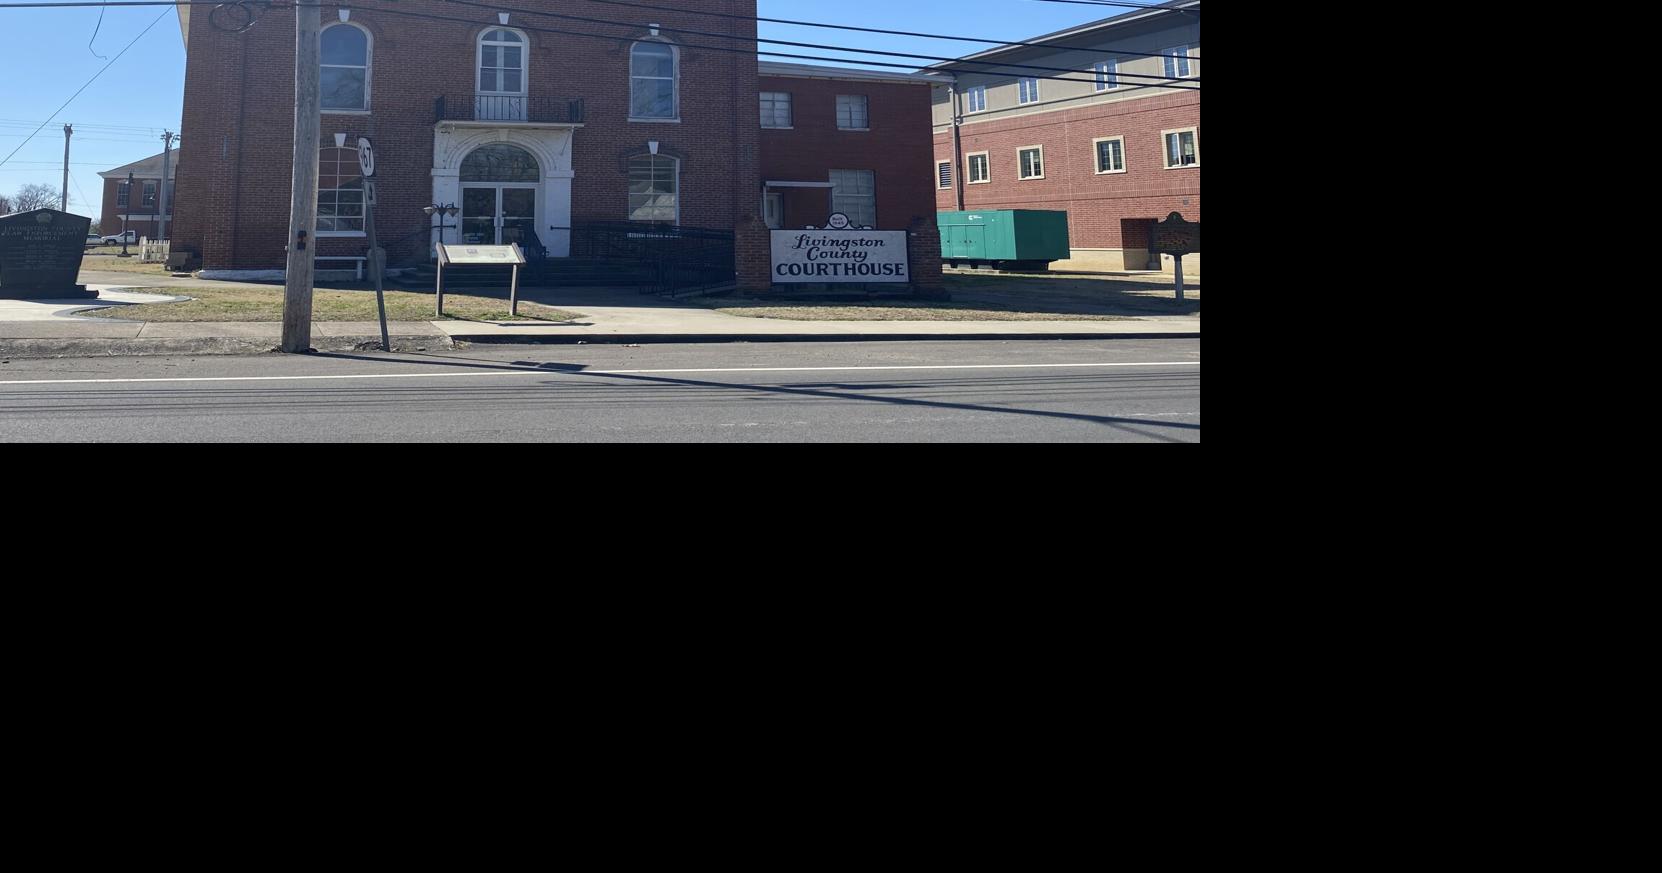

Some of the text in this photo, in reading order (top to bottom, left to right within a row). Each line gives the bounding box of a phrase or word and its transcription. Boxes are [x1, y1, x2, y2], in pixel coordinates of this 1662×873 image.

[792, 234, 885, 250] Livingston
[806, 246, 868, 263] County
[775, 262, 905, 276] COURTHOUSE
